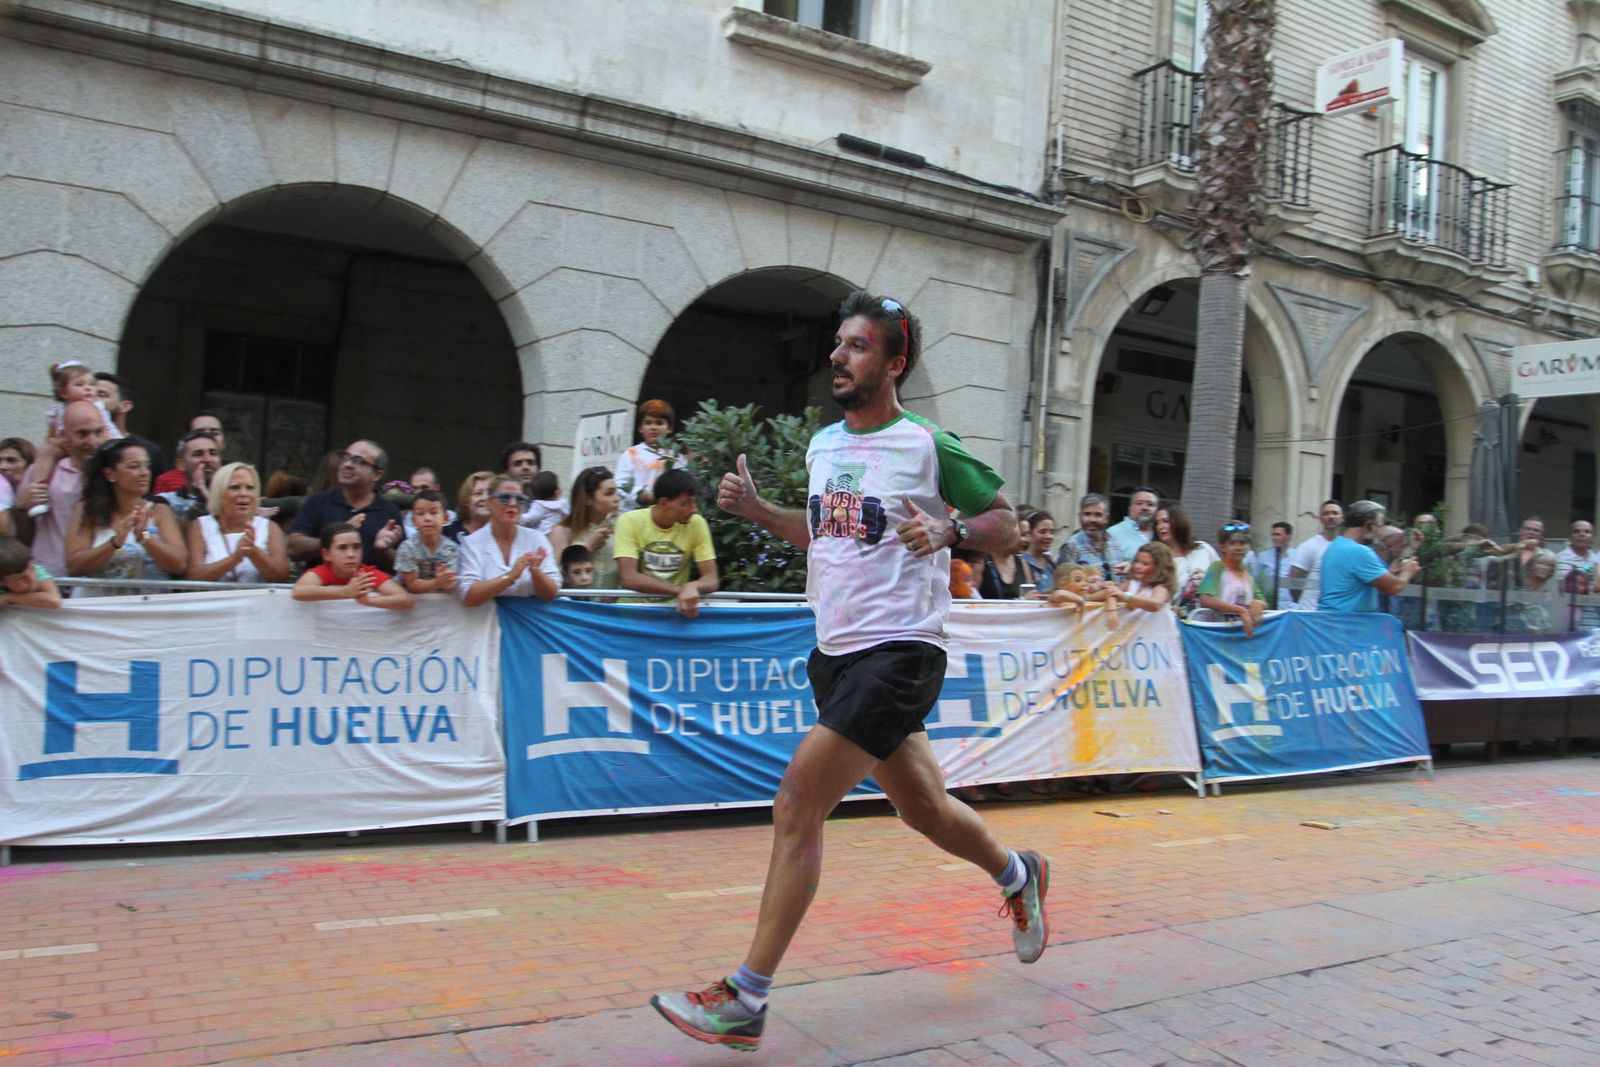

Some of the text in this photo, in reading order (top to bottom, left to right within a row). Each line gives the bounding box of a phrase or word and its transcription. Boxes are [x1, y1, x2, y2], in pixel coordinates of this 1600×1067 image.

[188, 648, 480, 698] DIPUTACIÓN
[998, 636, 1172, 682] DIPUTACIÓN
[1267, 645, 1403, 686] DIPUTACIÓN
[44, 660, 160, 754] H
[541, 653, 632, 736] H
[1002, 690, 1045, 721] DE
[1050, 678, 1162, 711] HUELVA
[1275, 691, 1311, 721] DE
[1310, 682, 1401, 716] HUELVA
[188, 708, 250, 751] DE
[270, 704, 458, 748] HUELVA
[651, 703, 701, 736] DE
